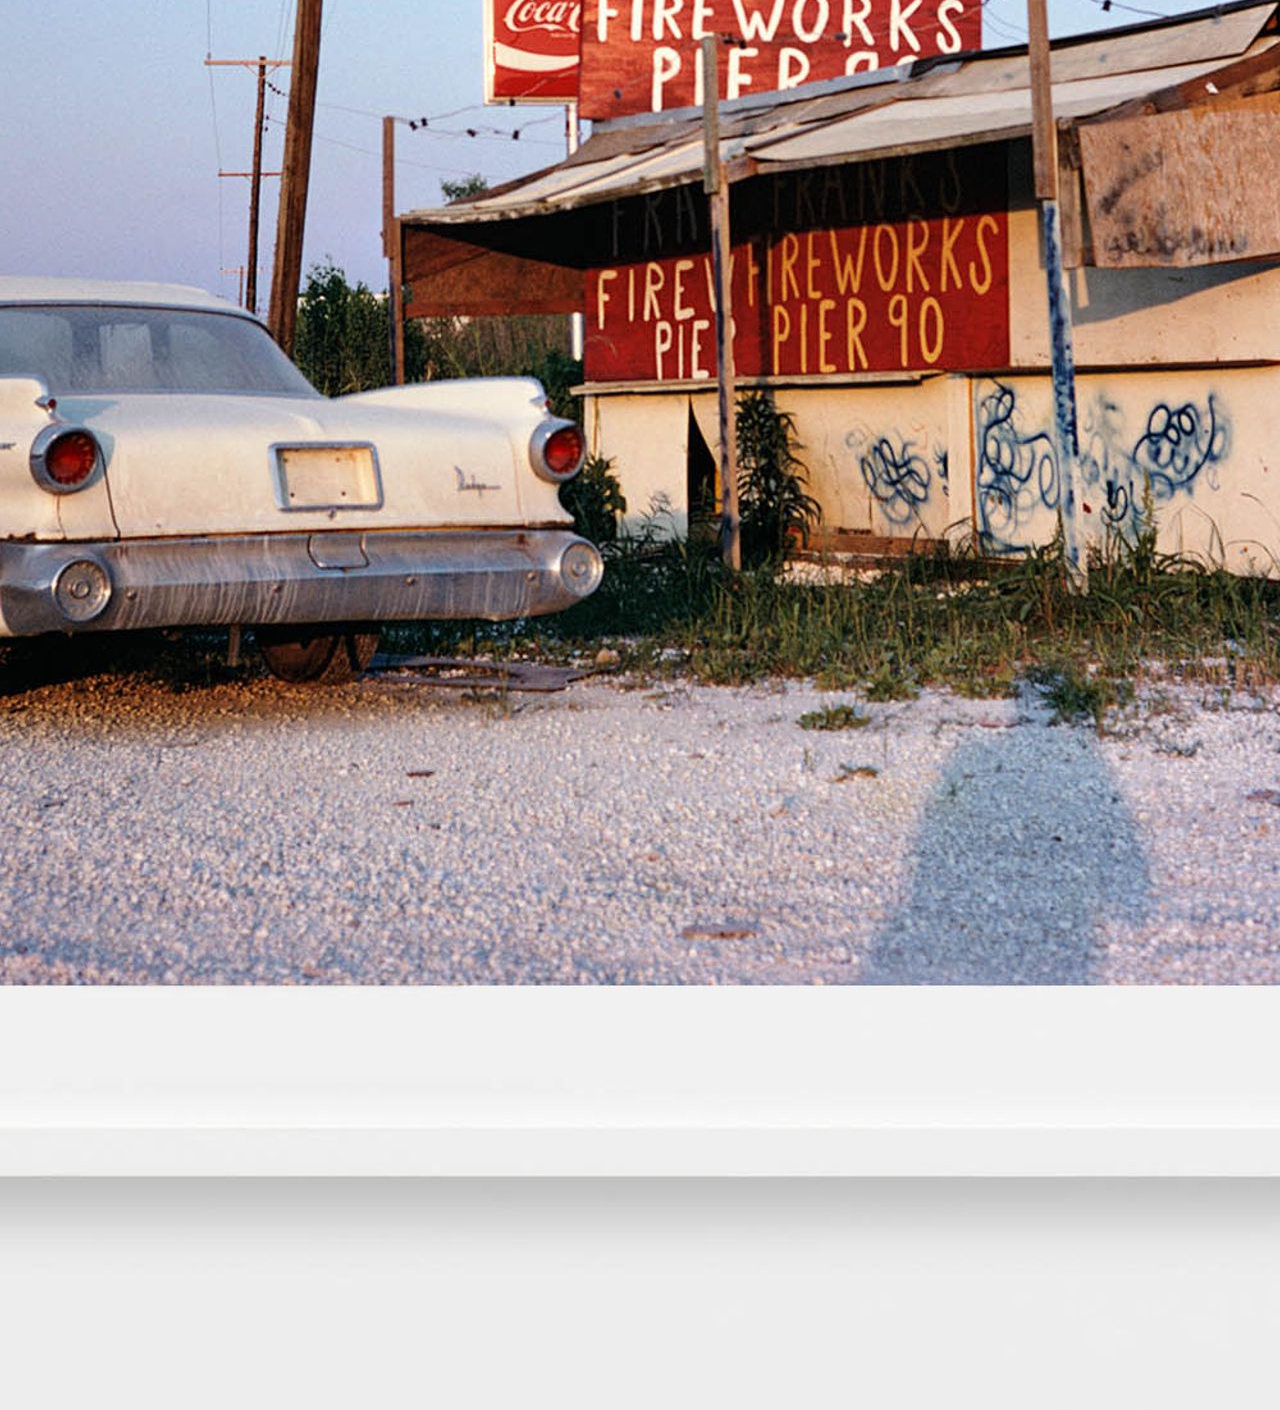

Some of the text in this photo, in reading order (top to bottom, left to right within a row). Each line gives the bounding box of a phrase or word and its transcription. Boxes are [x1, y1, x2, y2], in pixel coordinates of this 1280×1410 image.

[748, 214, 999, 307] FIREWORKS
[773, 293, 945, 375] PIER 90
